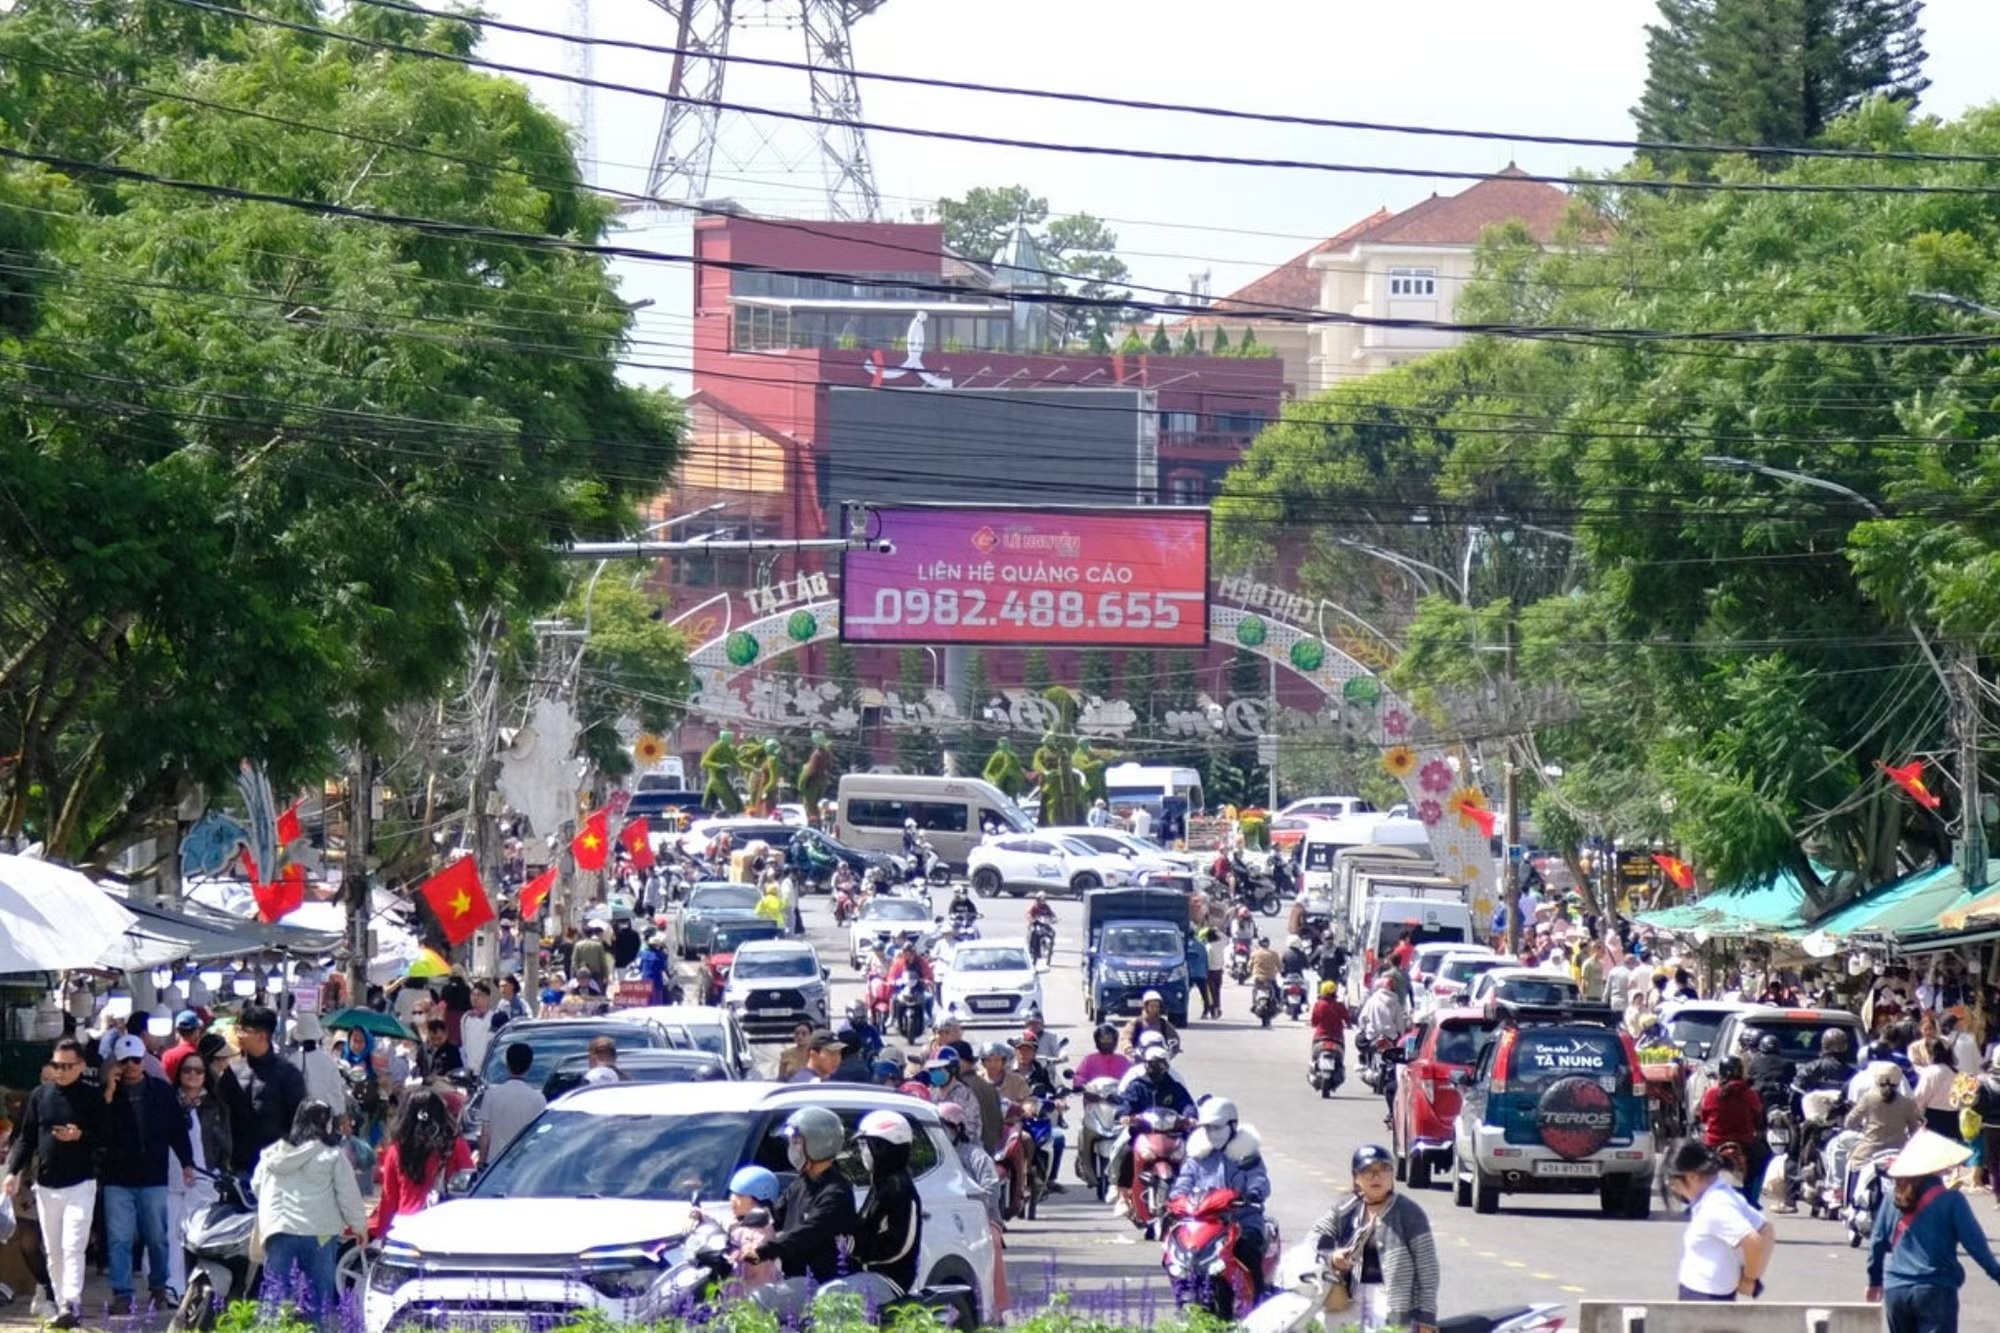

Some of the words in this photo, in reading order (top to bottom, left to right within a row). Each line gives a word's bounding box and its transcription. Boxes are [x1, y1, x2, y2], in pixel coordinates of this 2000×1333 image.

[918, 561, 961, 581] LIÊN
[968, 561, 995, 584] HỆ
[1001, 560, 1080, 582] QUẢNG
[1085, 563, 1132, 583] CÁO
[873, 588, 1181, 629] 0982.488.655
[1558, 1055, 1604, 1067] NUNG
[1543, 1112, 1612, 1125] TERIOS
